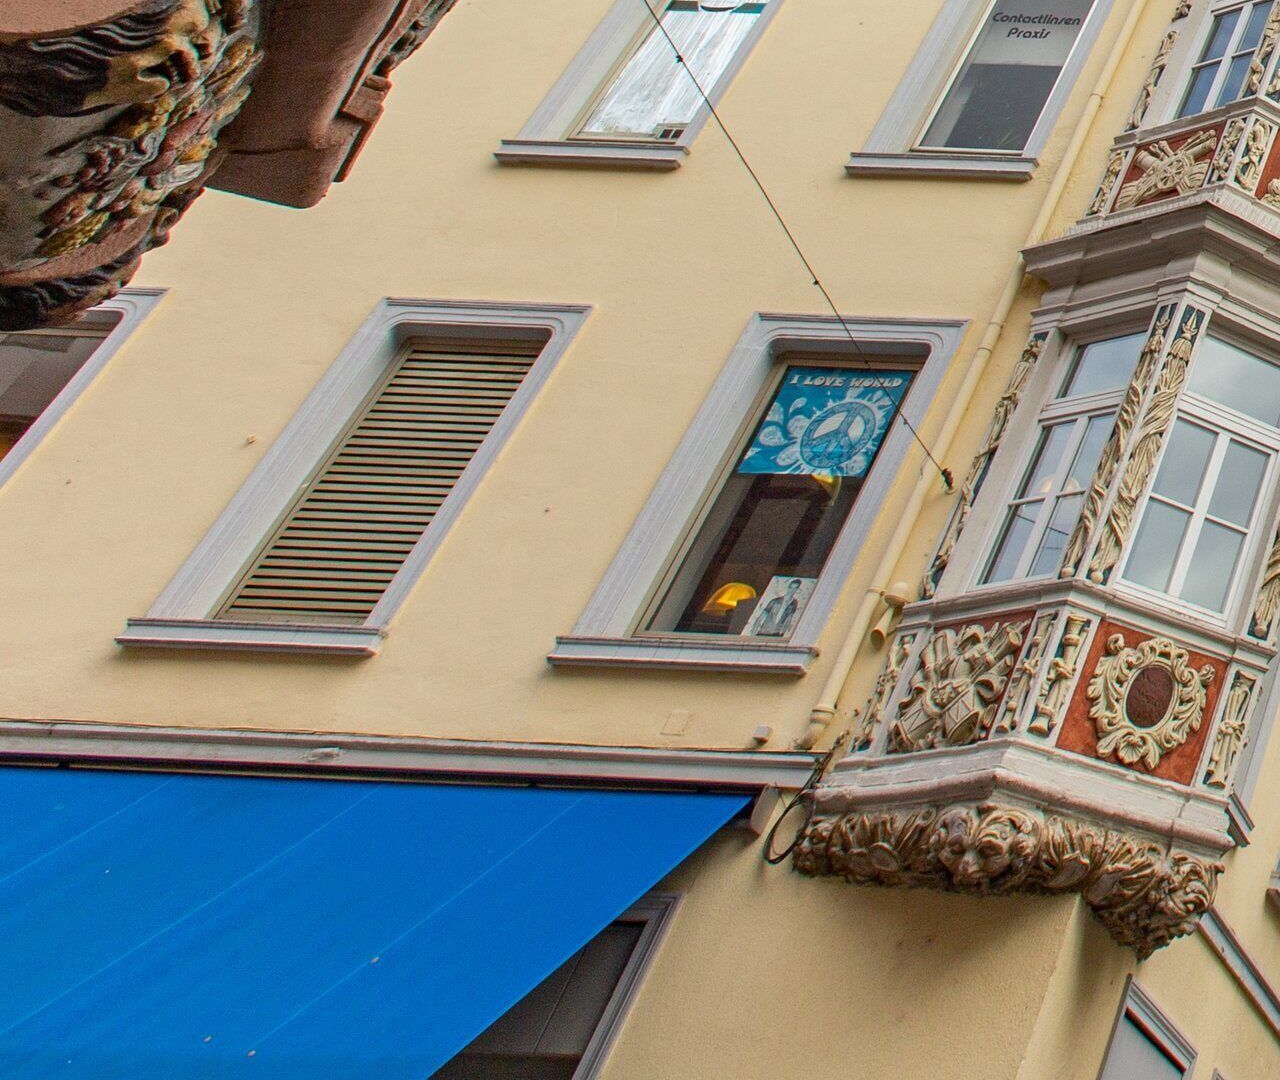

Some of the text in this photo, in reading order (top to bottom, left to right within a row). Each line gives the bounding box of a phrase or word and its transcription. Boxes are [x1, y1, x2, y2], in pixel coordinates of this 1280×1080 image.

[993, 12, 1081, 26] Contactlinsen
[1007, 28, 1051, 39] Praxis
[790, 375, 903, 388] I LOVE WORLD
